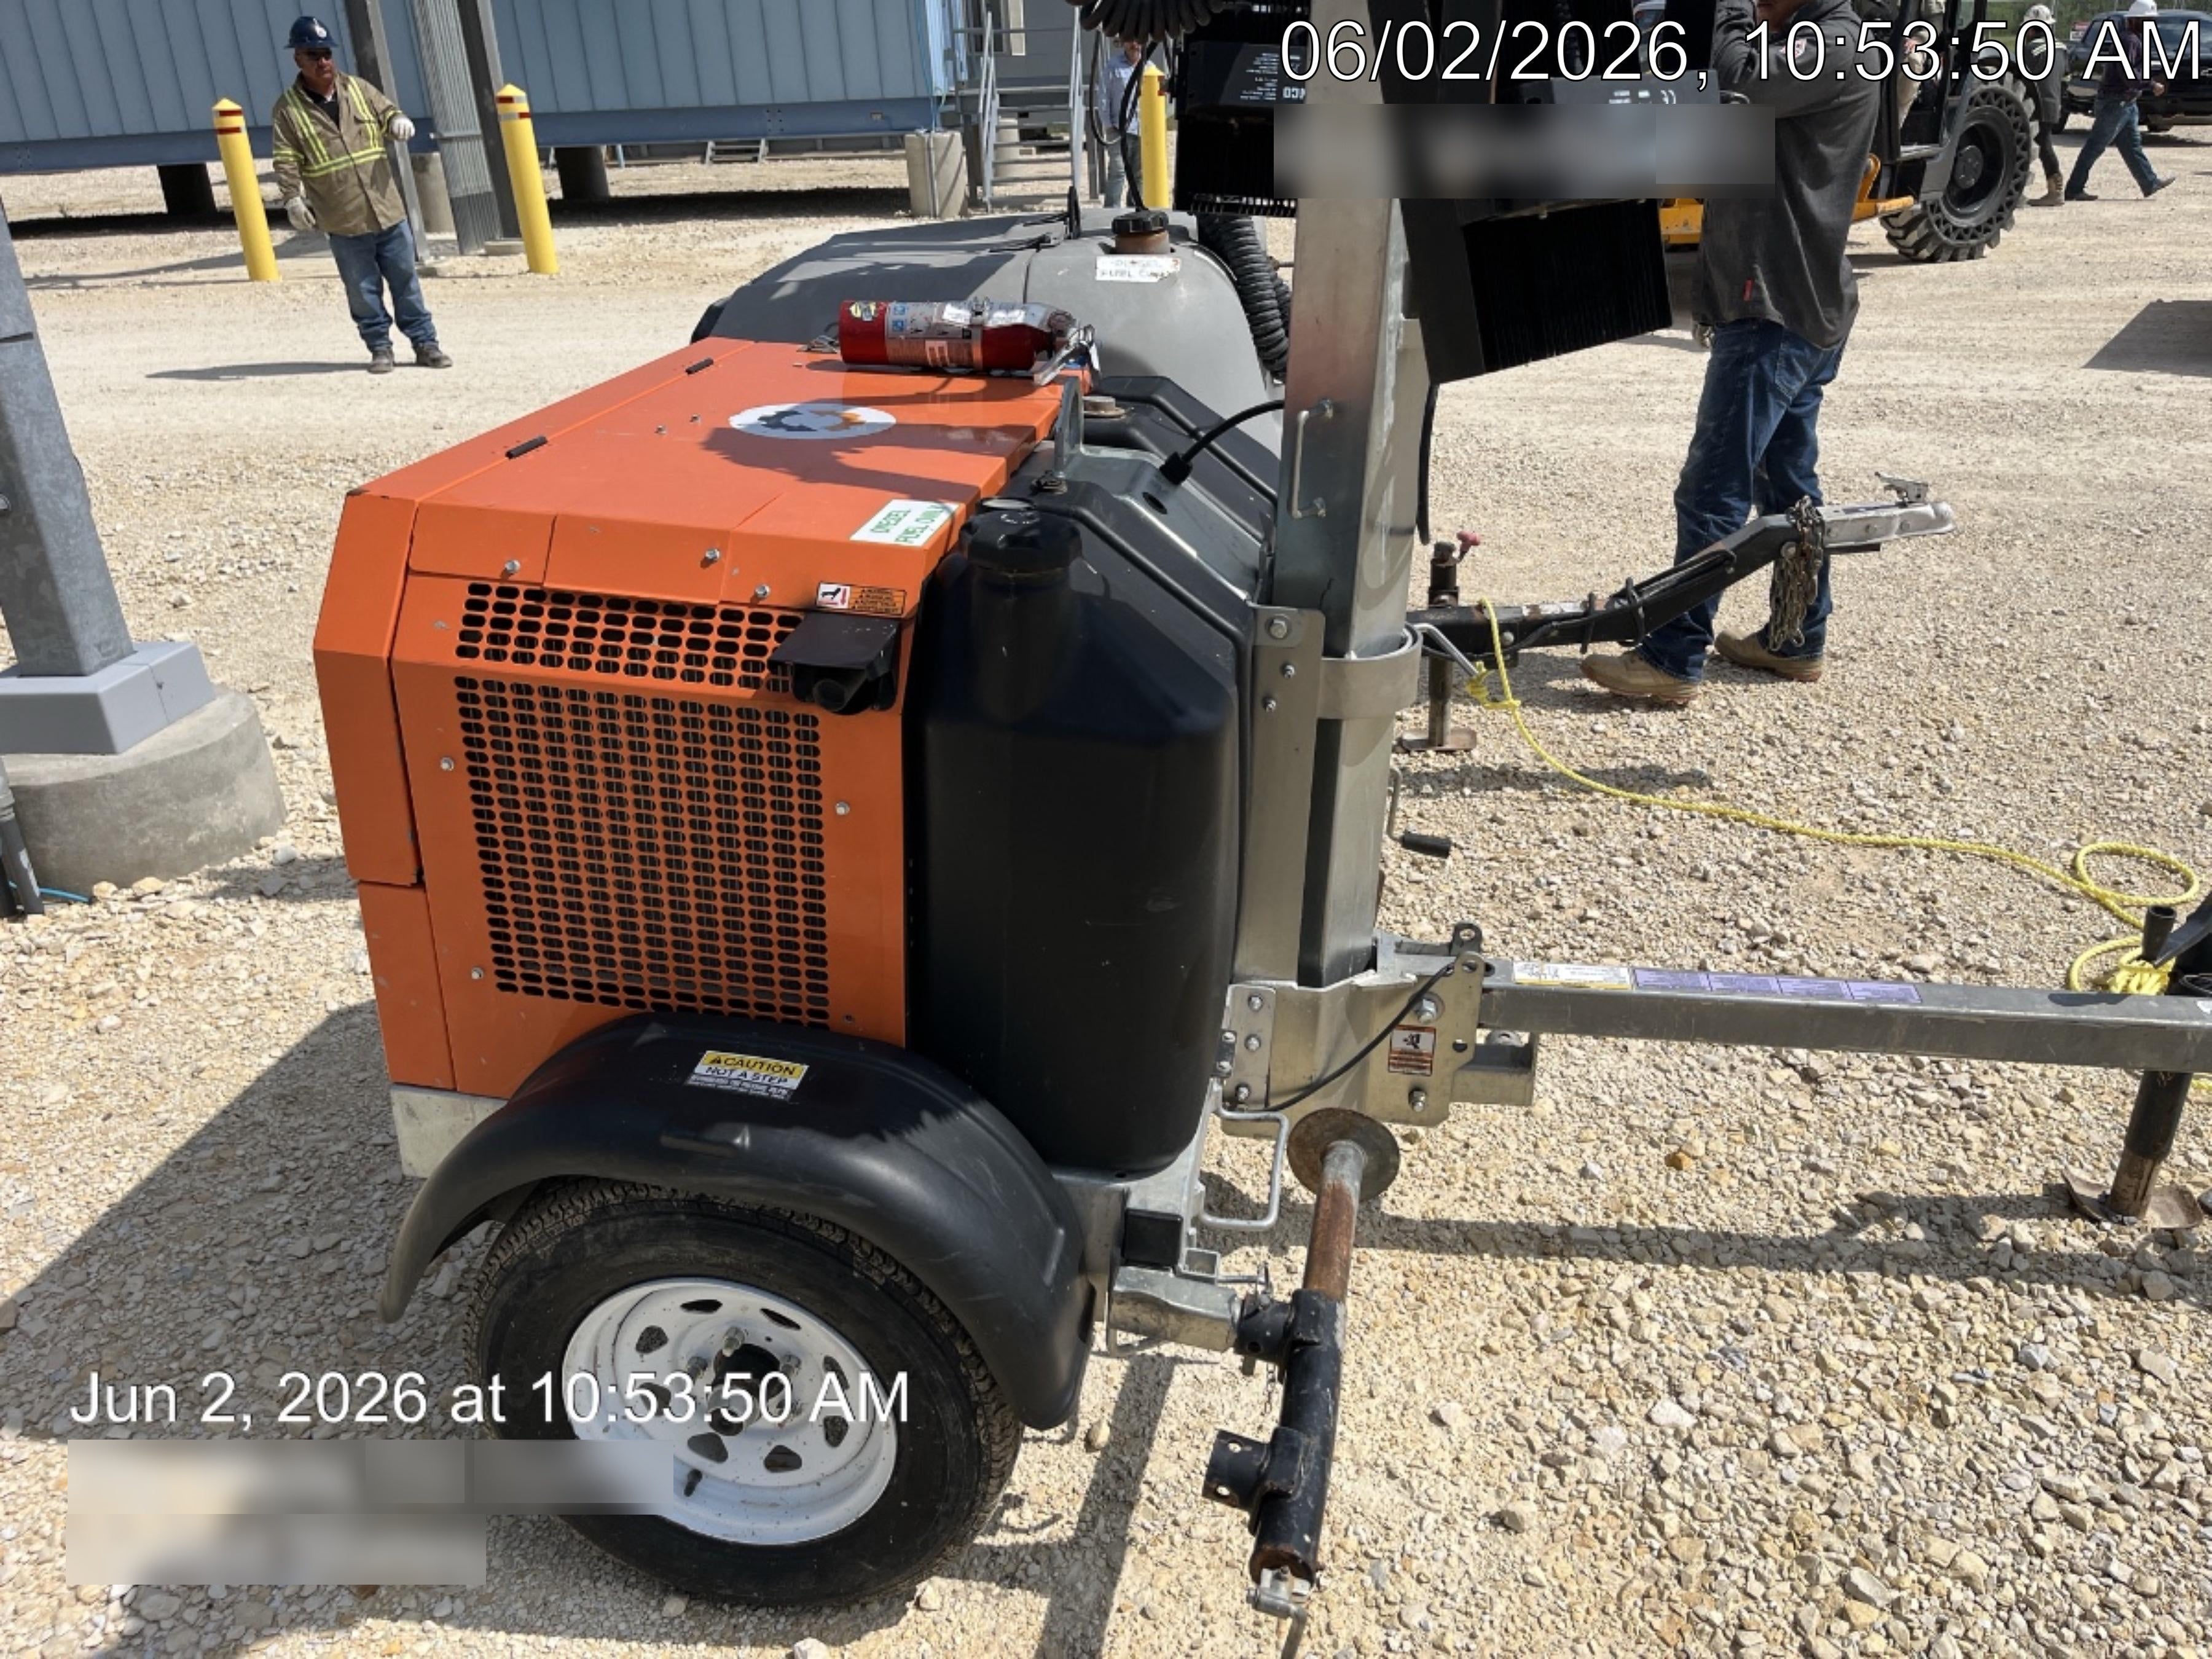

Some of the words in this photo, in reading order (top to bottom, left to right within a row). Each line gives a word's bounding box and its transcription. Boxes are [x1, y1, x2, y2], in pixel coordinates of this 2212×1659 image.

[705, 1066, 734, 1078] NOT
[738, 1072, 748, 1080] A
[751, 1073, 788, 1084] STEP
[723, 1057, 796, 1076] CAUTION
